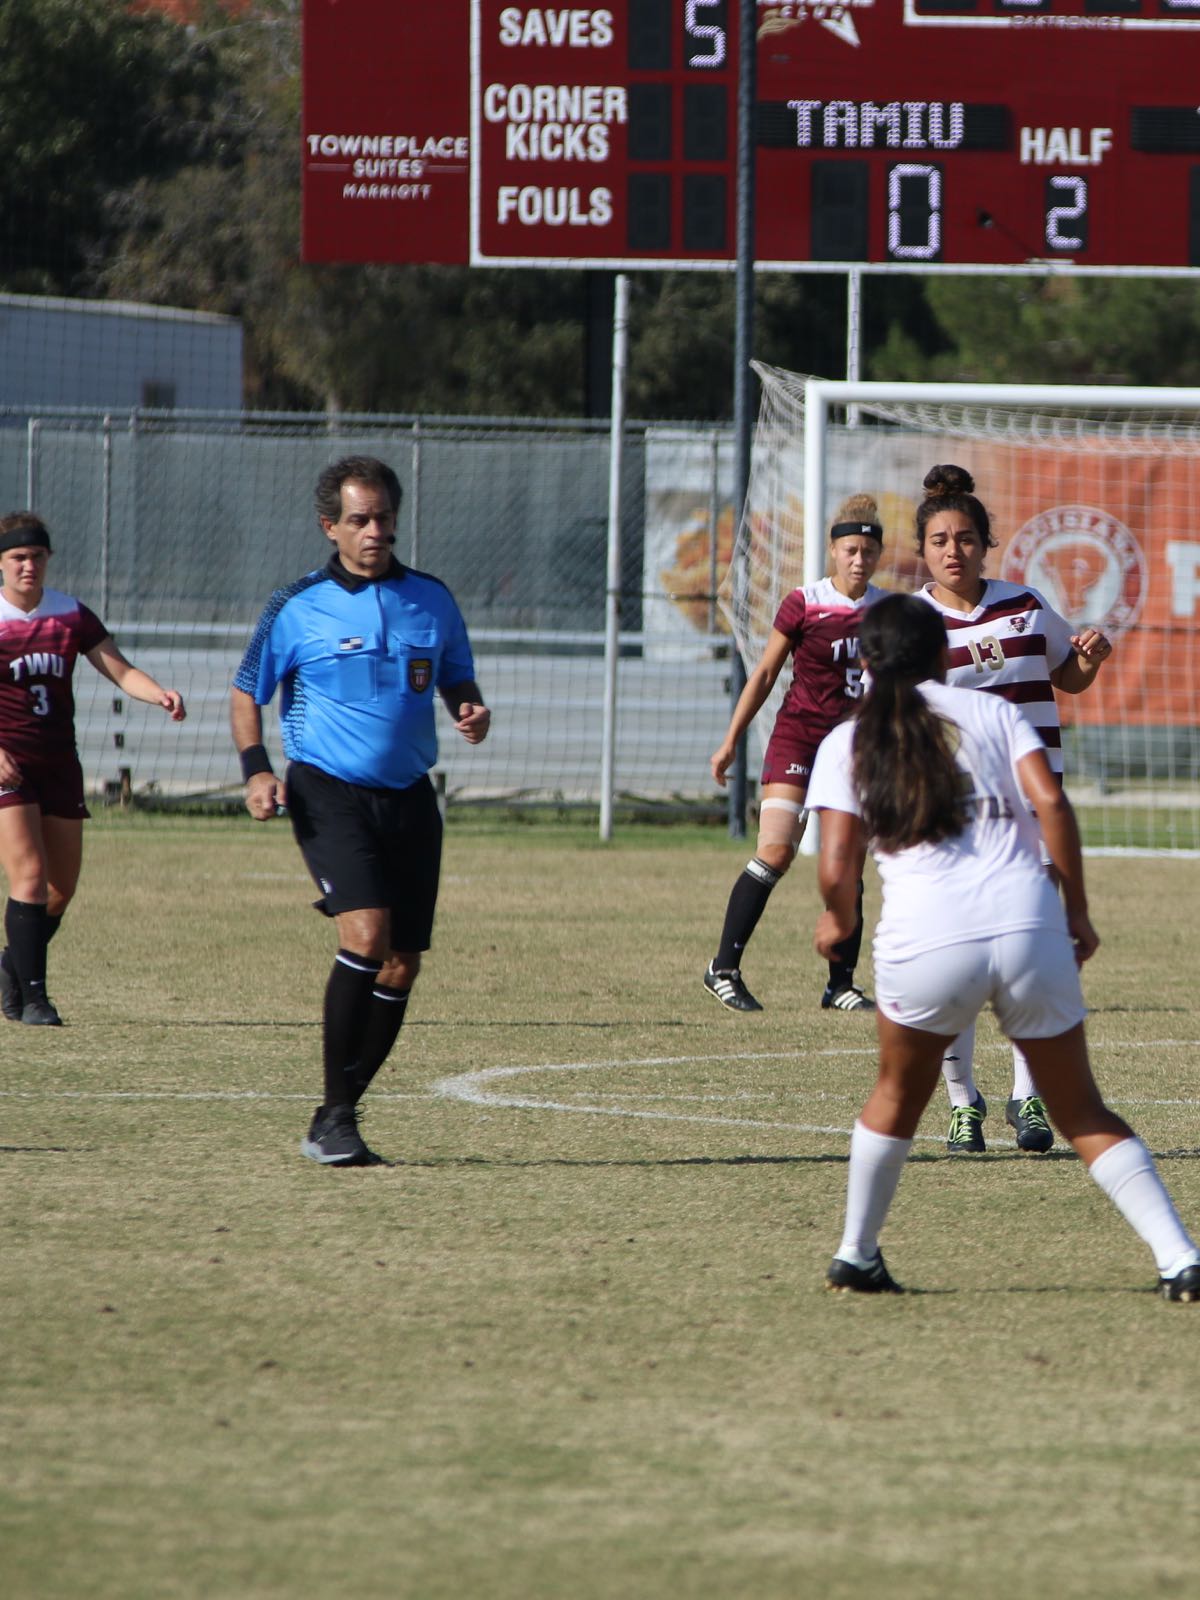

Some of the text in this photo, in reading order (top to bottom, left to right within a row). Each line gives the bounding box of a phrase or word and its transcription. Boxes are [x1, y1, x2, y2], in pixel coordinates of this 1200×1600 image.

[498, 7, 614, 48] SAVES
[685, 0, 726, 67] 5
[484, 84, 628, 123] CORNER
[506, 123, 609, 162] KICKS
[787, 100, 964, 149] TAMIU
[307, 134, 469, 158] TOWNEPLACE
[1020, 127, 1113, 165] HALF
[353, 158, 424, 179] SUITES
[342, 183, 432, 200] MARRIOTT
[497, 186, 613, 226] FOULS
[888, 164, 941, 259] 0
[1045, 176, 1087, 249] 2
[9, 653, 64, 681] TWU
[967, 635, 1004, 674] 13
[30, 684, 49, 716] 3
[844, 668, 862, 699] 5
